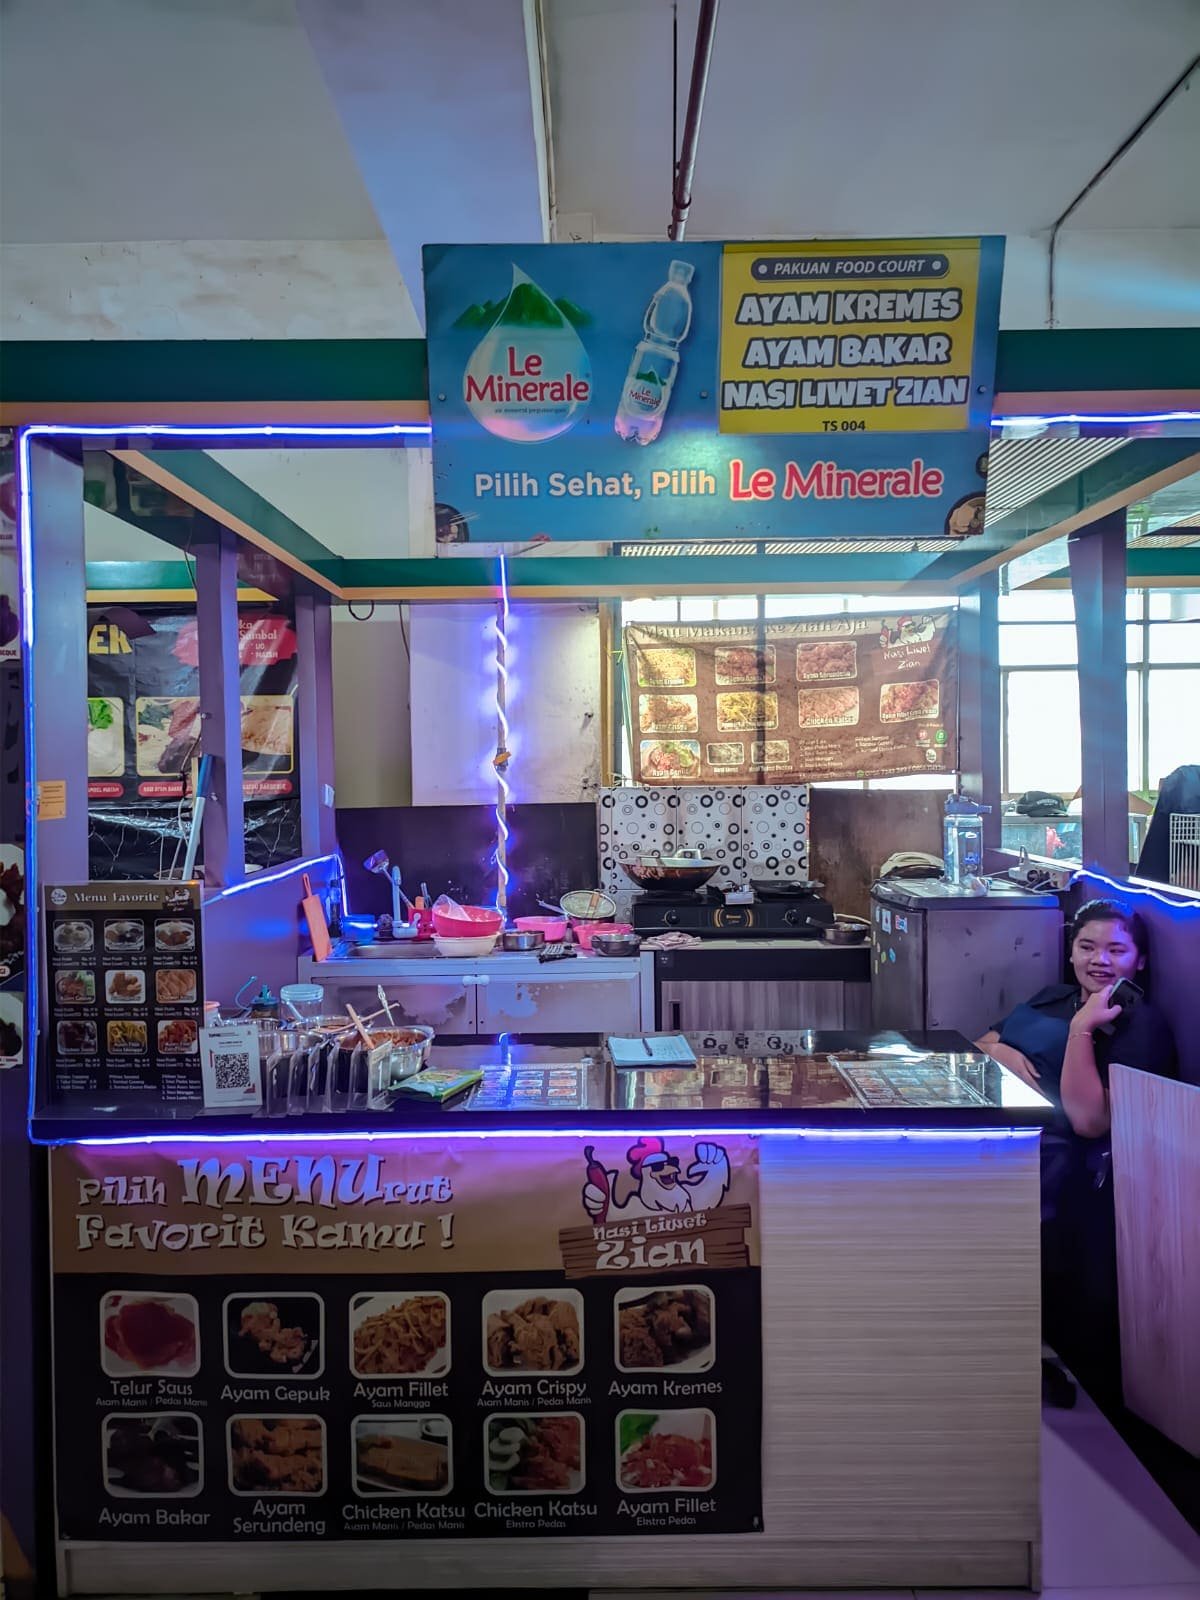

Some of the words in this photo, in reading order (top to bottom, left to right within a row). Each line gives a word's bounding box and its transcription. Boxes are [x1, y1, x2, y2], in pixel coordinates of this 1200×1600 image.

[773, 262, 830, 276] PAKUAN
[834, 260, 875, 274] FOOD
[877, 259, 927, 273] COURT
[736, 291, 832, 325] AYAM
[832, 288, 962, 324] KREMES
[742, 335, 838, 369] AYAM
[838, 333, 953, 368] BAKAR
[508, 346, 542, 377] Le
[465, 373, 589, 402] Minerale
[721, 380, 800, 410] NASI
[799, 378, 894, 409] LIWET
[894, 376, 970, 407] ZIAN
[821, 421, 838, 431] TS
[841, 420, 866, 431] 004
[474, 471, 539, 498] Pilih
[548, 471, 642, 500] Sehat,
[651, 469, 716, 496] Pilih
[729, 459, 775, 501] Le
[782, 458, 944, 500] Minerale
[239, 629, 277, 640] Sambal
[897, 660, 921, 670] Zian
[74, 891, 107, 902] Menu
[112, 891, 160, 902] Favorite
[76, 1175, 167, 1207] Pilih
[76, 1213, 266, 1252] Favorit
[280, 1213, 427, 1252] Kamu
[592, 1221, 640, 1241] Nasi
[645, 1212, 708, 1234] Liwet
[596, 1236, 709, 1271] Zian
[109, 1379, 153, 1397] Telur
[158, 1378, 194, 1396] Saus
[220, 1384, 270, 1403] Ayam
[274, 1385, 331, 1404] Gepuk
[352, 1382, 407, 1401] Ayam
[408, 1380, 449, 1398] Fillet
[481, 1380, 532, 1399] Ayam
[536, 1379, 587, 1398] Crispy
[607, 1379, 658, 1398] Ayam
[662, 1379, 723, 1397] Kremes
[371, 1399, 393, 1408] Saus
[394, 1399, 431, 1409] Mangga
[98, 1507, 151, 1527] Ayam
[155, 1508, 211, 1525] Bakar
[252, 1498, 306, 1518] Ayam
[341, 1503, 411, 1520] Chicken
[416, 1502, 465, 1519] Katsu
[473, 1501, 543, 1519] Chicken
[548, 1501, 598, 1517] Katsu
[616, 1499, 670, 1518] Ayam
[674, 1497, 718, 1513] Fillet
[232, 1517, 326, 1536] Serundeng
[538, 1519, 567, 1528] Pedas
[668, 1515, 697, 1526] Pedas
